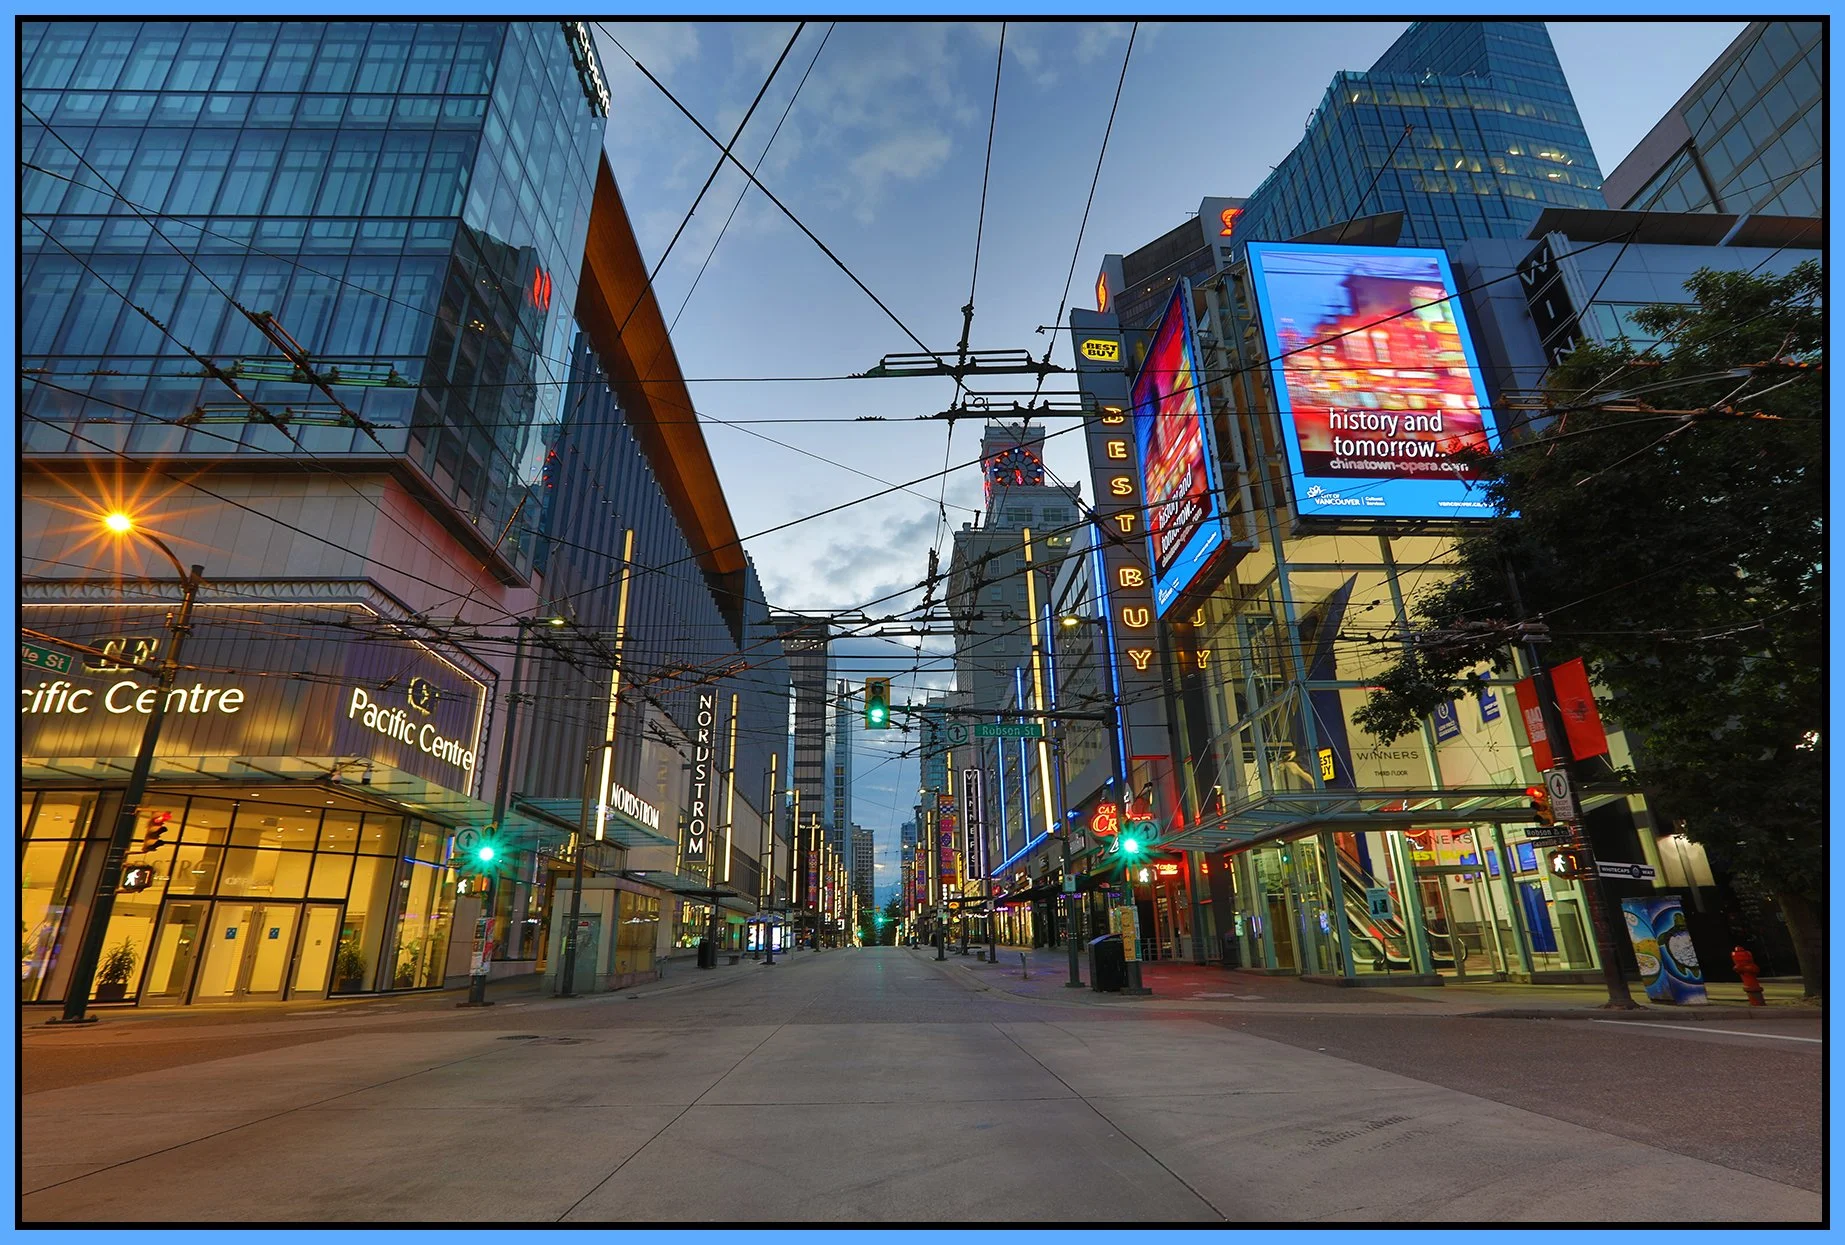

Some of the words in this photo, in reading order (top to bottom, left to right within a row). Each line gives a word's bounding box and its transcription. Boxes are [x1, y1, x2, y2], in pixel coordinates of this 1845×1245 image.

[1085, 342, 1118, 350] BEST
[1087, 349, 1115, 358] BUY
[1328, 407, 1400, 437] history
[1403, 409, 1444, 433] and
[1314, 498, 1361, 506] VANCOUVER
[1118, 567, 1152, 671] BUY
[45, 654, 65, 669] St
[104, 681, 245, 714] Centre
[348, 687, 416, 745] Pacific
[419, 723, 473, 771] Centre
[982, 725, 1021, 736] Robson
[1024, 725, 1035, 736] St
[1319, 755, 1331, 767] EST
[1356, 750, 1419, 761] WINNERS
[688, 694, 713, 854] NORDSTROM
[1320, 765, 1331, 776] UY
[610, 782, 660, 830] NORDSTROM
[1098, 805, 1117, 815] CAF
[1526, 828, 1552, 837] Robson
[1600, 866, 1631, 874] WHITECAPS
[1641, 868, 1655, 876] WAY
